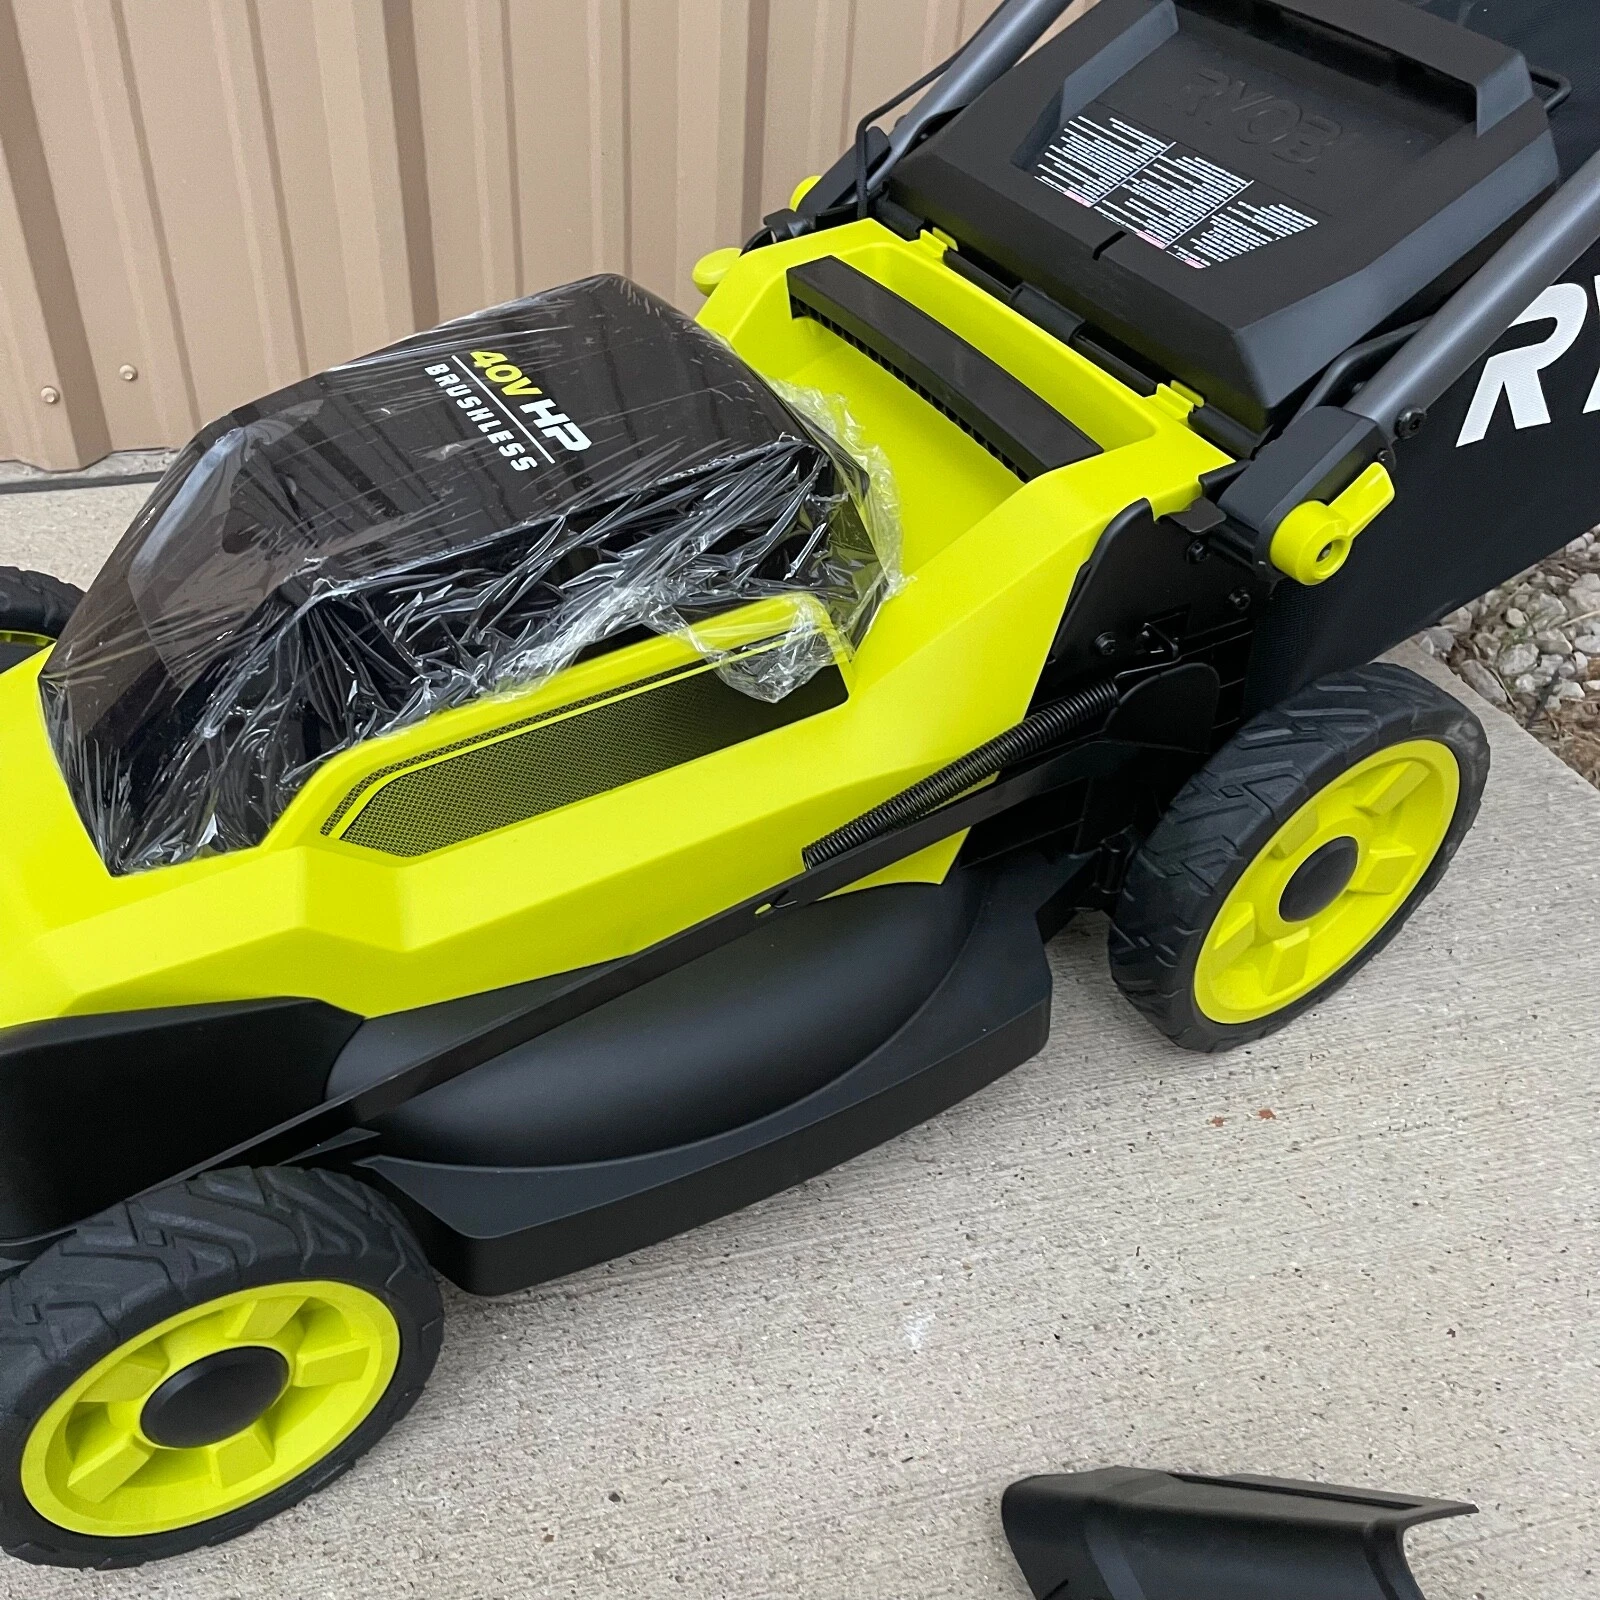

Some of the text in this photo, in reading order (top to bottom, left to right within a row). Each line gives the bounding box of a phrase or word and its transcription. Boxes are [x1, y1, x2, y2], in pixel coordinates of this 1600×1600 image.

[1163, 66, 1360, 175] RYOB
[470, 350, 592, 452] 40V HP
[1456, 275, 1600, 448] R
[424, 363, 538, 471] BRUSHLESS
